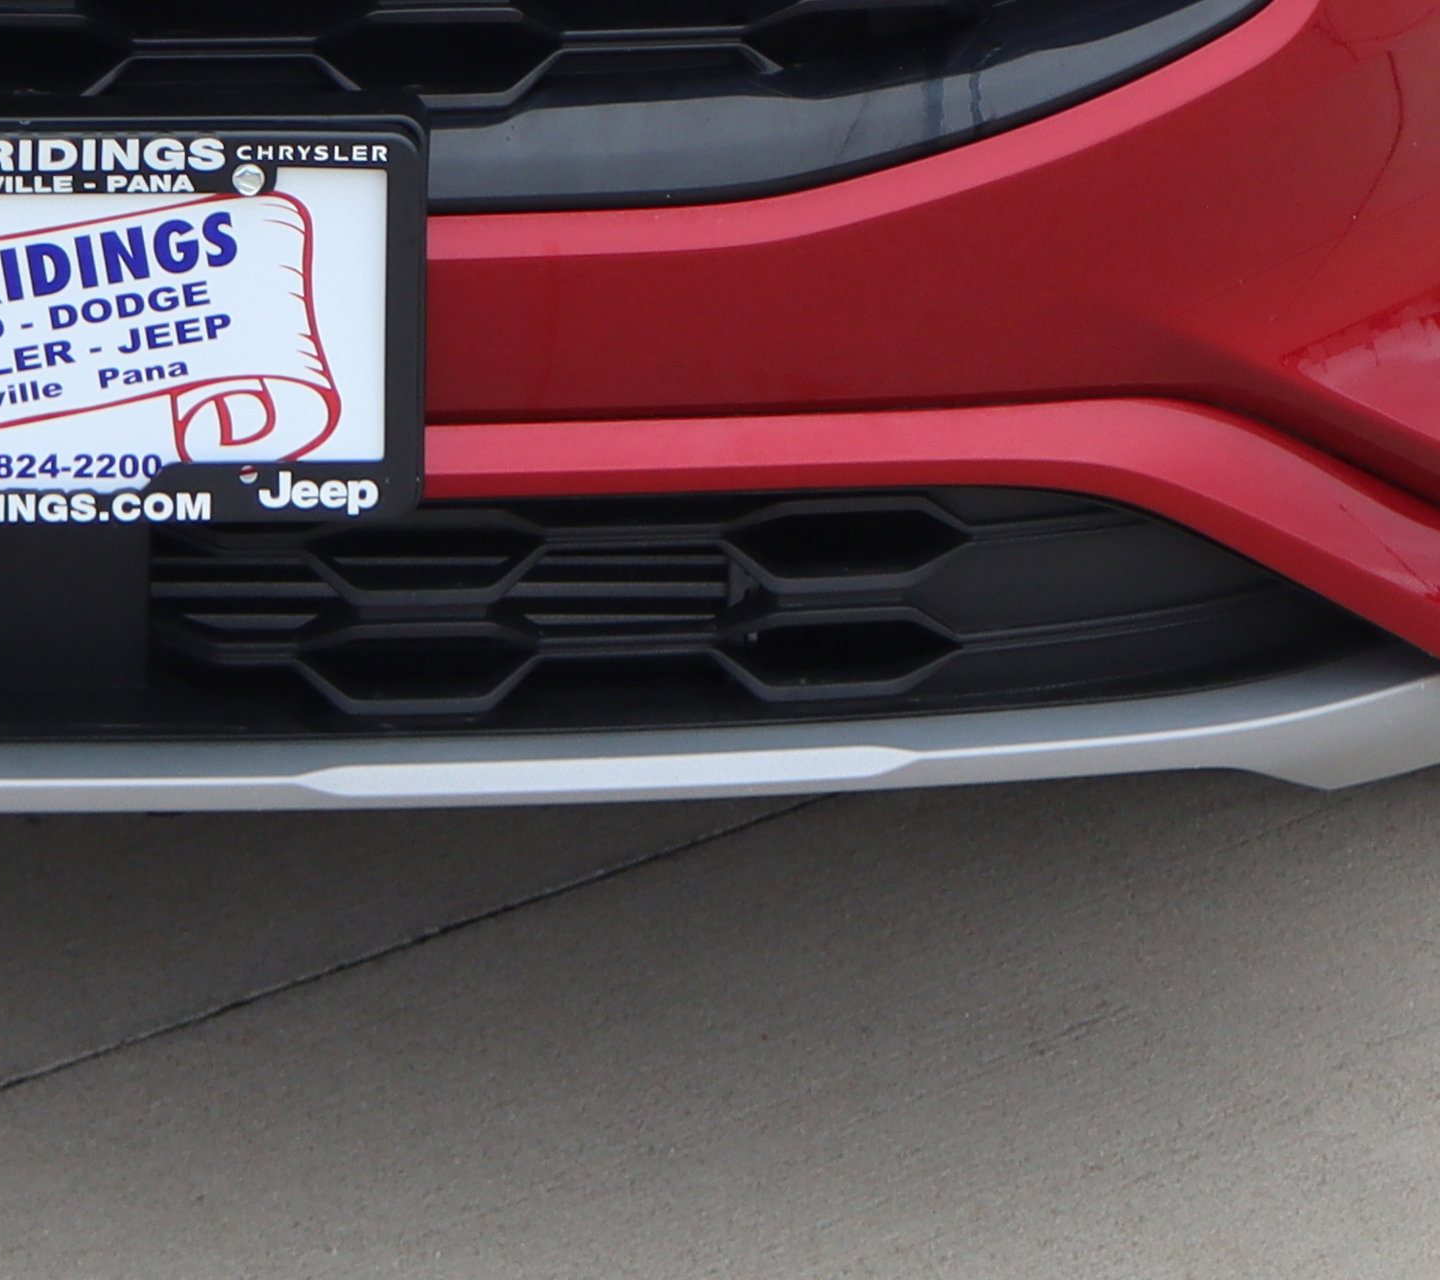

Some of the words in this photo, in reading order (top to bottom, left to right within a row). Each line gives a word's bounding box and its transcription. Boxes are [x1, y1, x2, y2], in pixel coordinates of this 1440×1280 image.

[235, 144, 389, 162] CHRYSLER
[106, 174, 195, 194] PANA
[48, 280, 211, 330] DODGE
[117, 313, 232, 354] JEEP
[98, 360, 189, 389] Pana
[258, 470, 379, 516] Jeep
